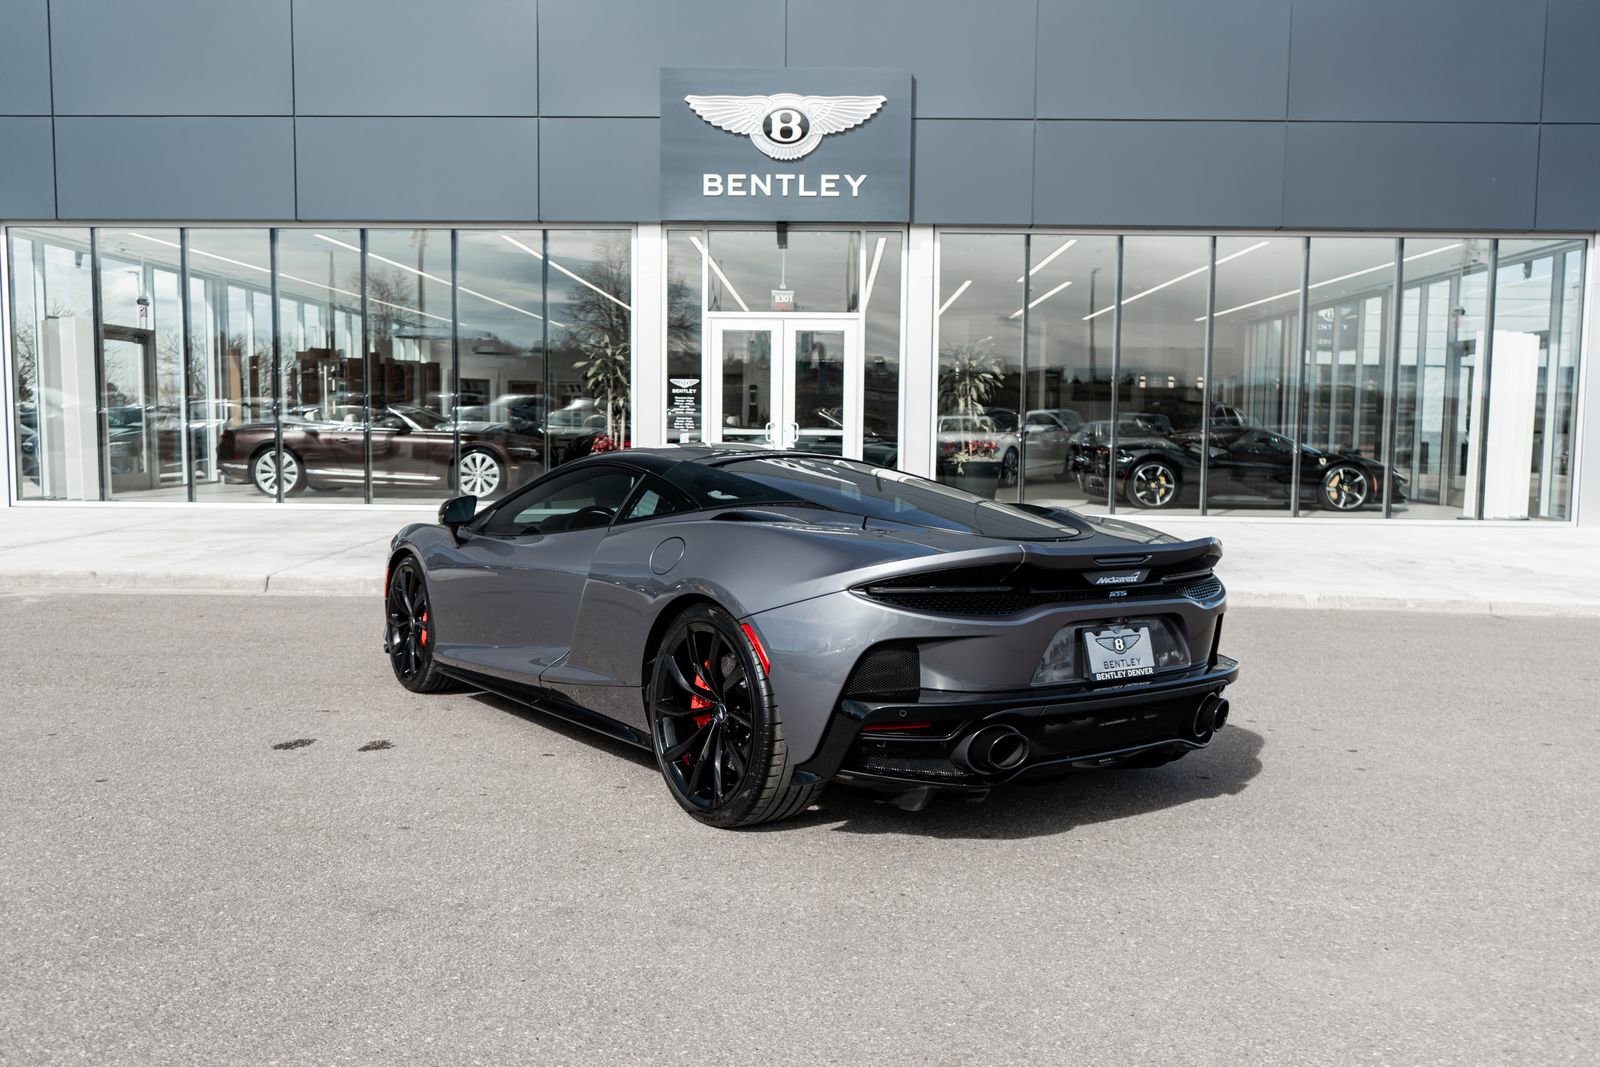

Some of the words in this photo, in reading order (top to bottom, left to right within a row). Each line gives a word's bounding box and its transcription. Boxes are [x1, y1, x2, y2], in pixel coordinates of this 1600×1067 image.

[703, 173, 868, 197] BENTLEY
[1096, 573, 1140, 584] McLaren
[1103, 657, 1141, 670] BENTLEY
[1096, 670, 1127, 680] BENTLEY
[1127, 667, 1154, 677] DENVER
